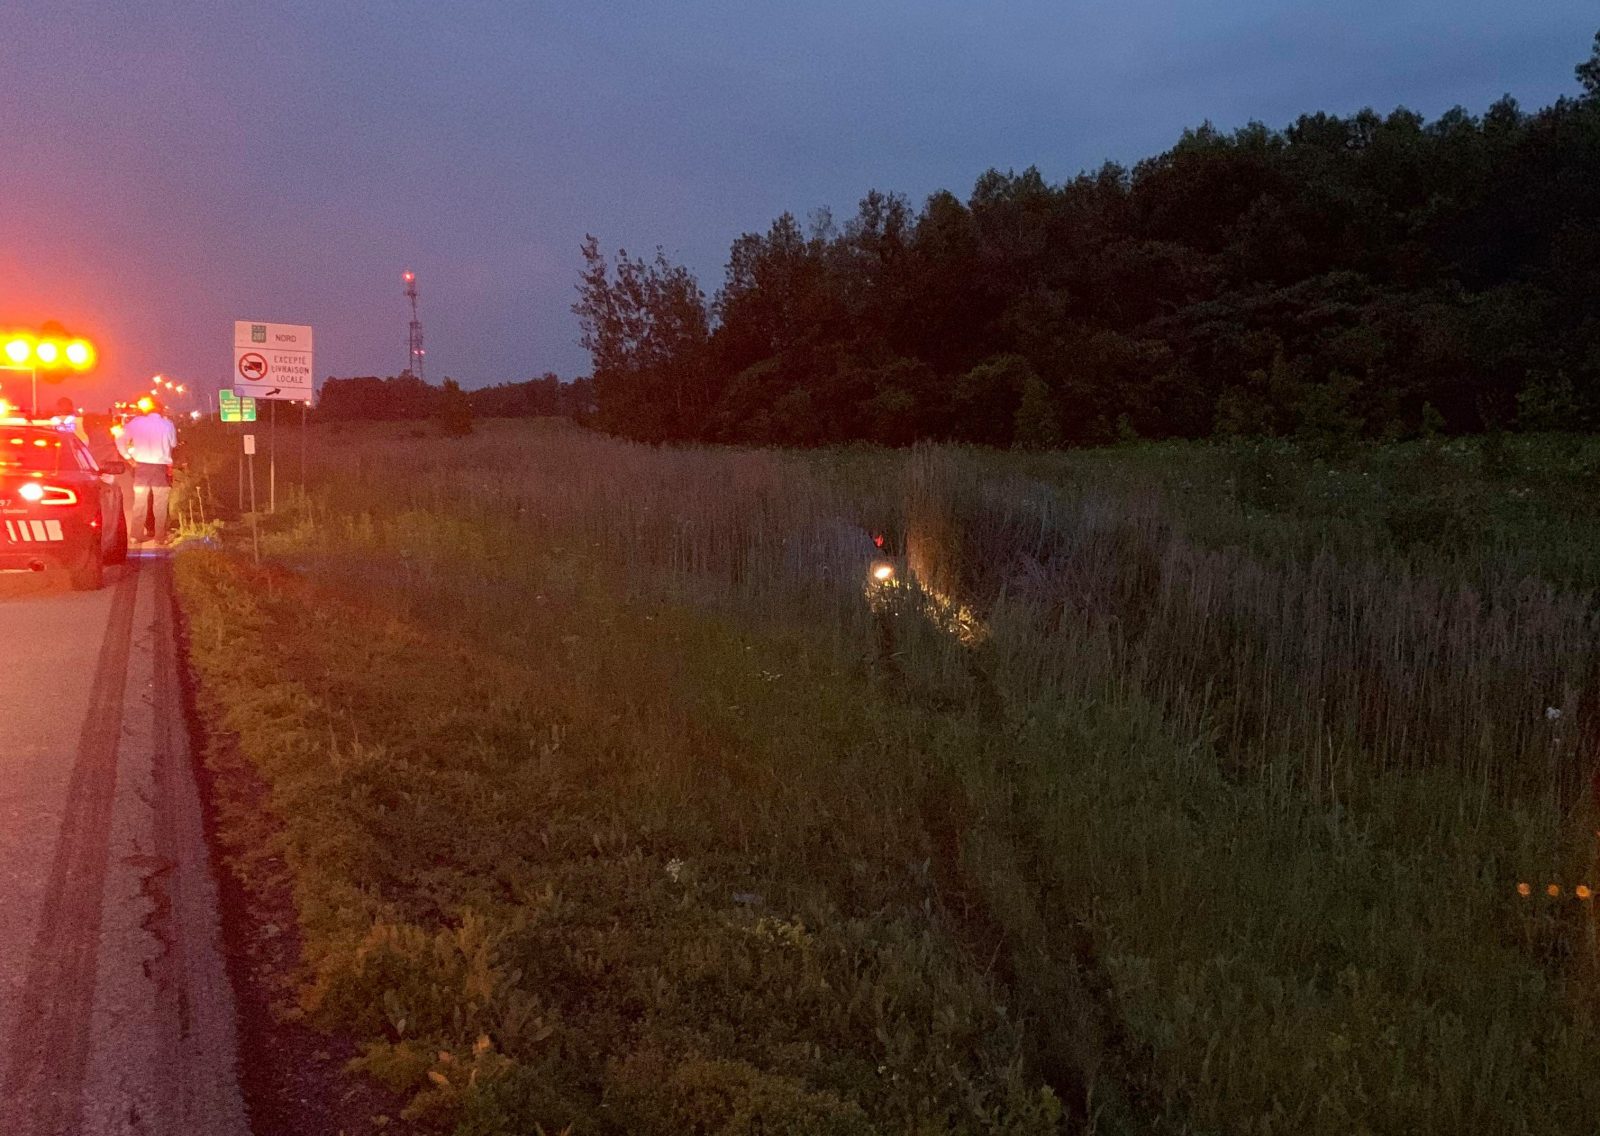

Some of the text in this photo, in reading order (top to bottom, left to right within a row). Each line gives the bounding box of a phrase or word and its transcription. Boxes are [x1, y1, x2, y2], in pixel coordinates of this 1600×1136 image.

[275, 334, 297, 343] NORD
[271, 365, 310, 375] LIVRAISON
[276, 374, 304, 384] LOCALE
